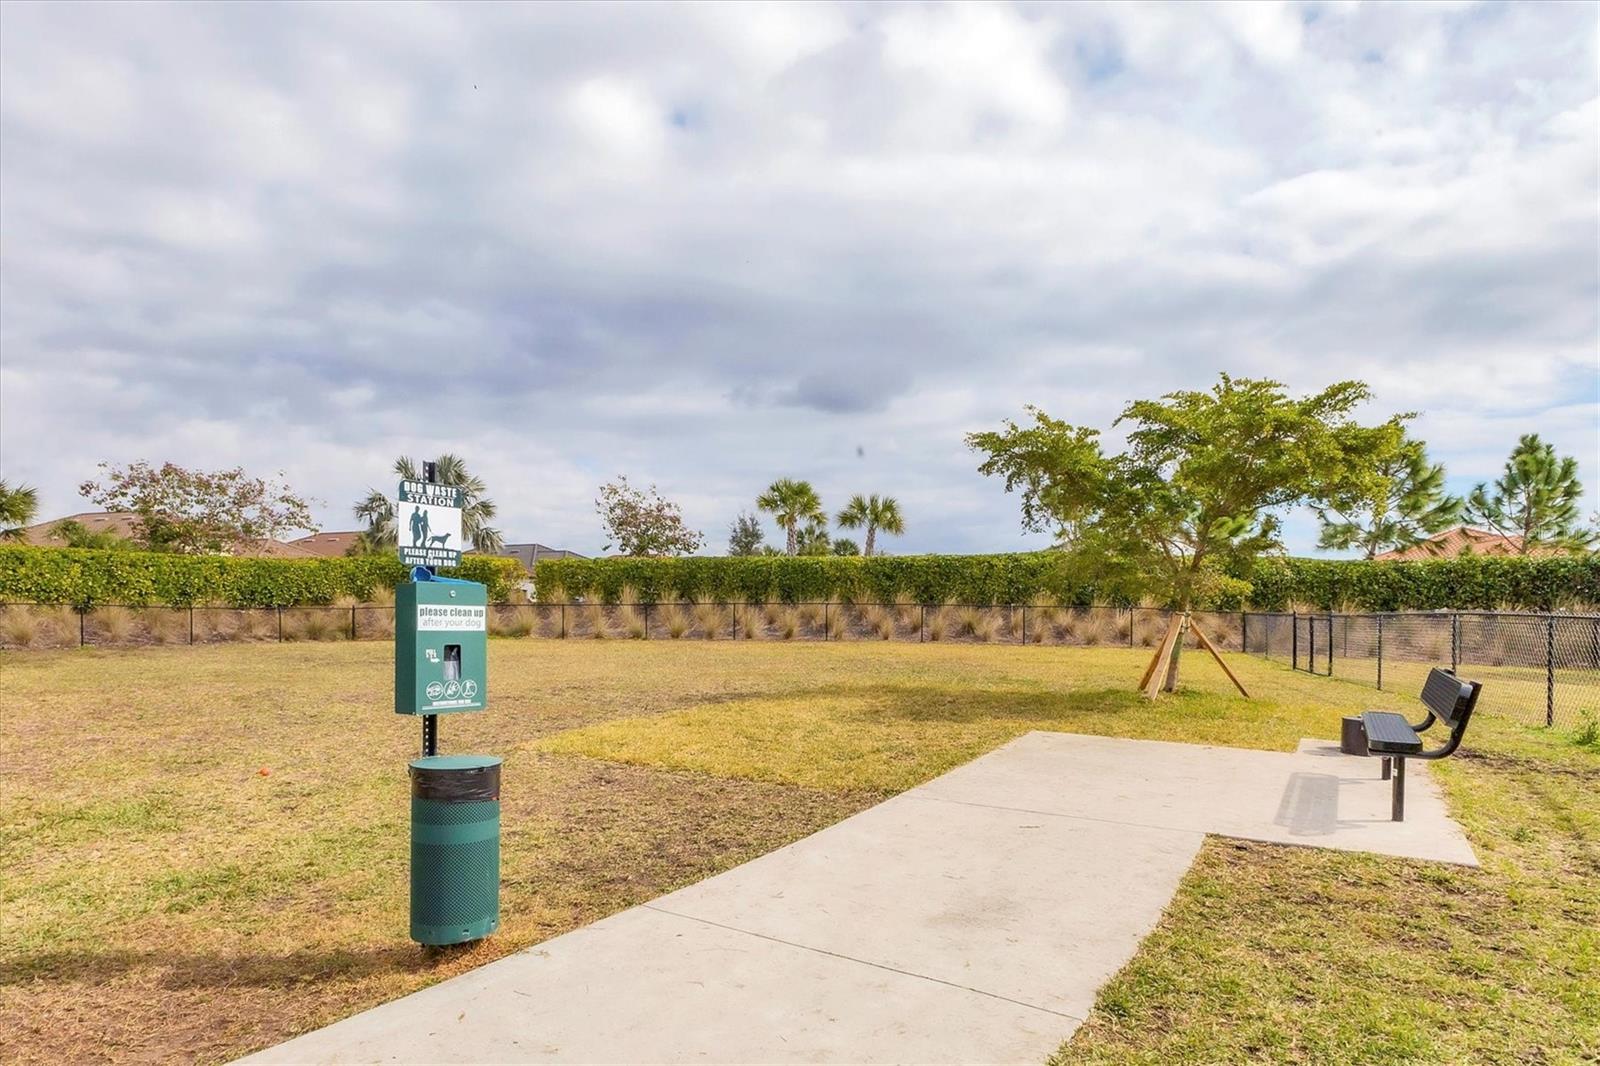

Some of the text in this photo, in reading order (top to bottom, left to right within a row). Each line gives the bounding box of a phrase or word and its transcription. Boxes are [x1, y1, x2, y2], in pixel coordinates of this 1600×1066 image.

[404, 481, 457, 498] DOG WASTE
[407, 494, 454, 507] STATION
[404, 548, 457, 559] PLEASE CLEAN UP
[405, 556, 425, 565] AFTER
[425, 558, 442, 566] YOUR
[419, 607, 484, 618] please clean up
[422, 617, 482, 629] after your dog
